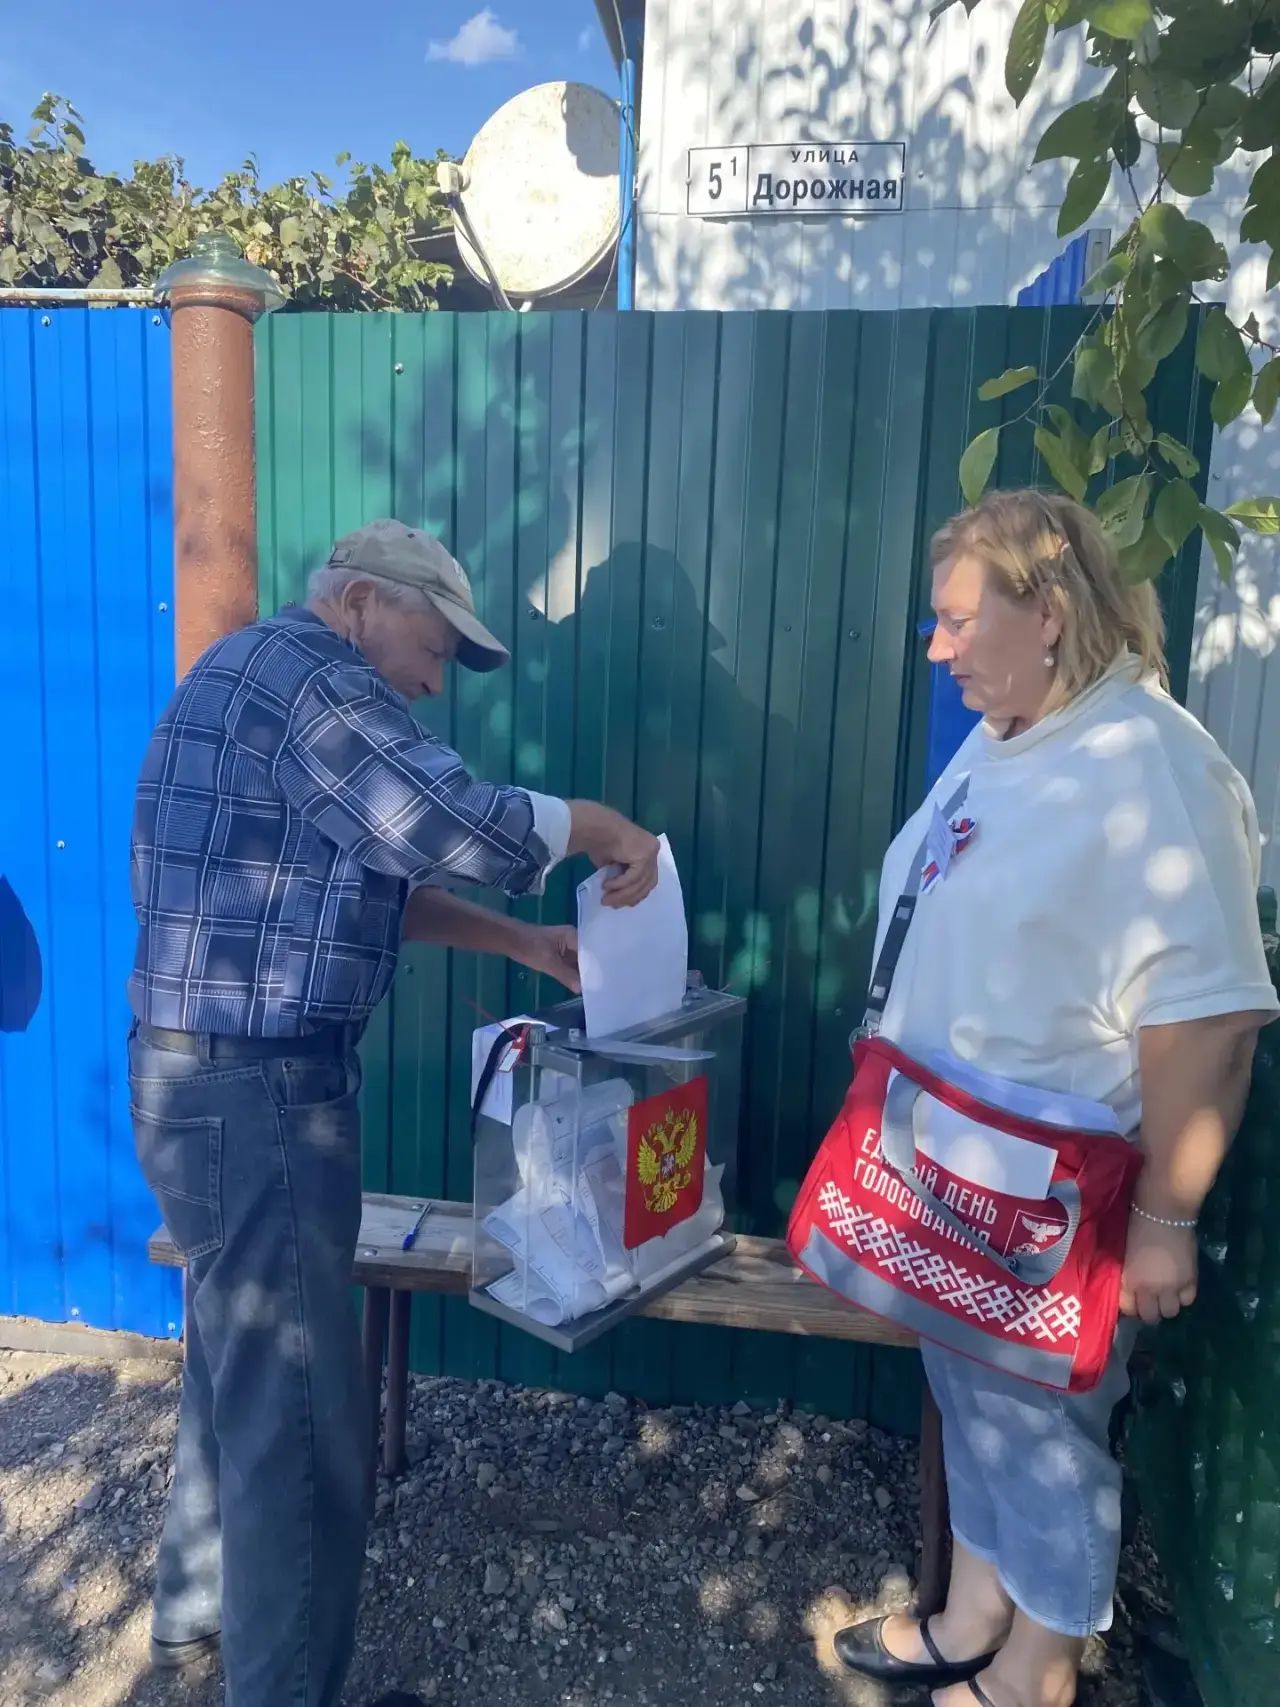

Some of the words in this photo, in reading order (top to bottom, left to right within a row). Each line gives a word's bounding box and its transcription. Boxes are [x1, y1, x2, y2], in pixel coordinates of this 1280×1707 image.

[791, 150, 860, 165] УЛИЦА
[752, 173, 898, 206] Дорожная
[940, 1181, 998, 1225] ДЕНЬ
